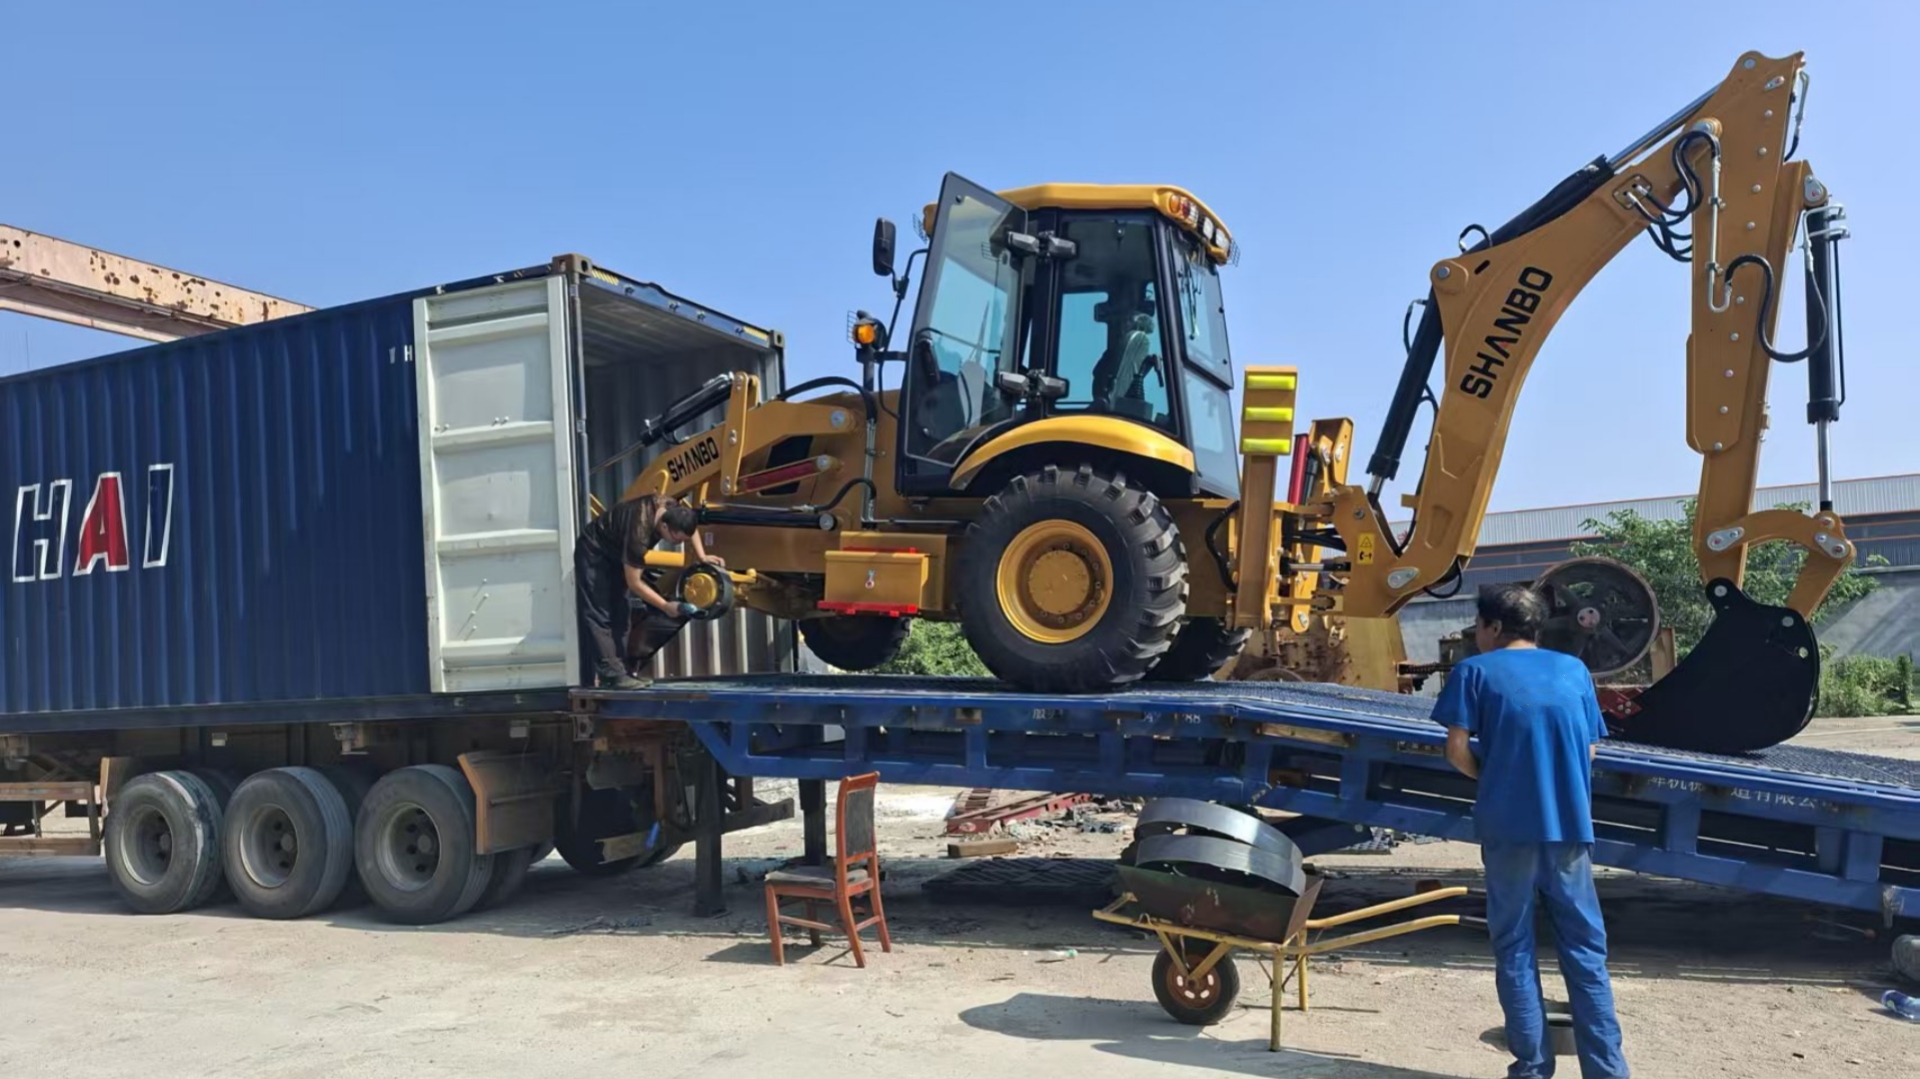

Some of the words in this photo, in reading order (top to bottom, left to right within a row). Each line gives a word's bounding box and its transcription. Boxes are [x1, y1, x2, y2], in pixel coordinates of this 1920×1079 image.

[1460, 266, 1553, 399] SHANBO
[667, 436, 719, 483] SHANBO
[12, 463, 174, 583] HAI
